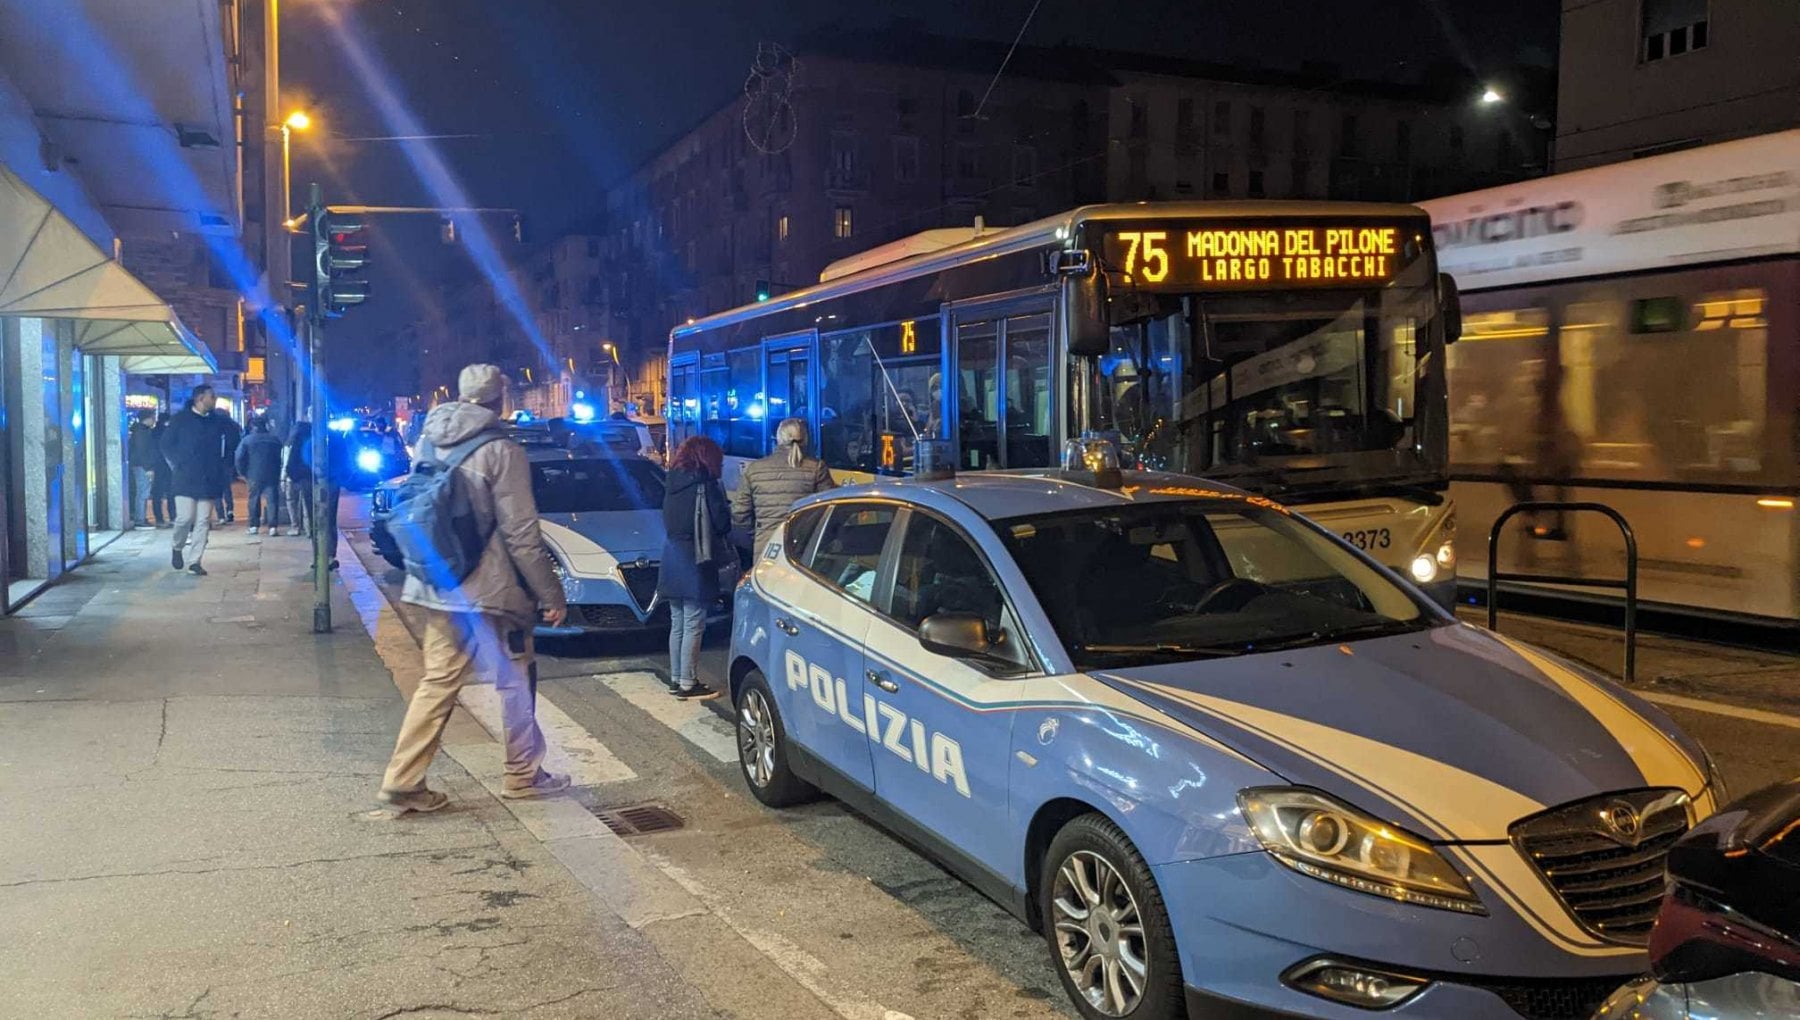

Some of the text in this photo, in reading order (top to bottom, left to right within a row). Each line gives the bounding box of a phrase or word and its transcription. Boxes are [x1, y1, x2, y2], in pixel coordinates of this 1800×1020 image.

[1119, 231, 1168, 282] 75
[1187, 228, 1394, 258] MADONNA DEL PILONE
[1202, 255, 1385, 280] LARGO TABACCHI
[901, 320, 915, 352] 75
[785, 650, 971, 799] POLIZIA
